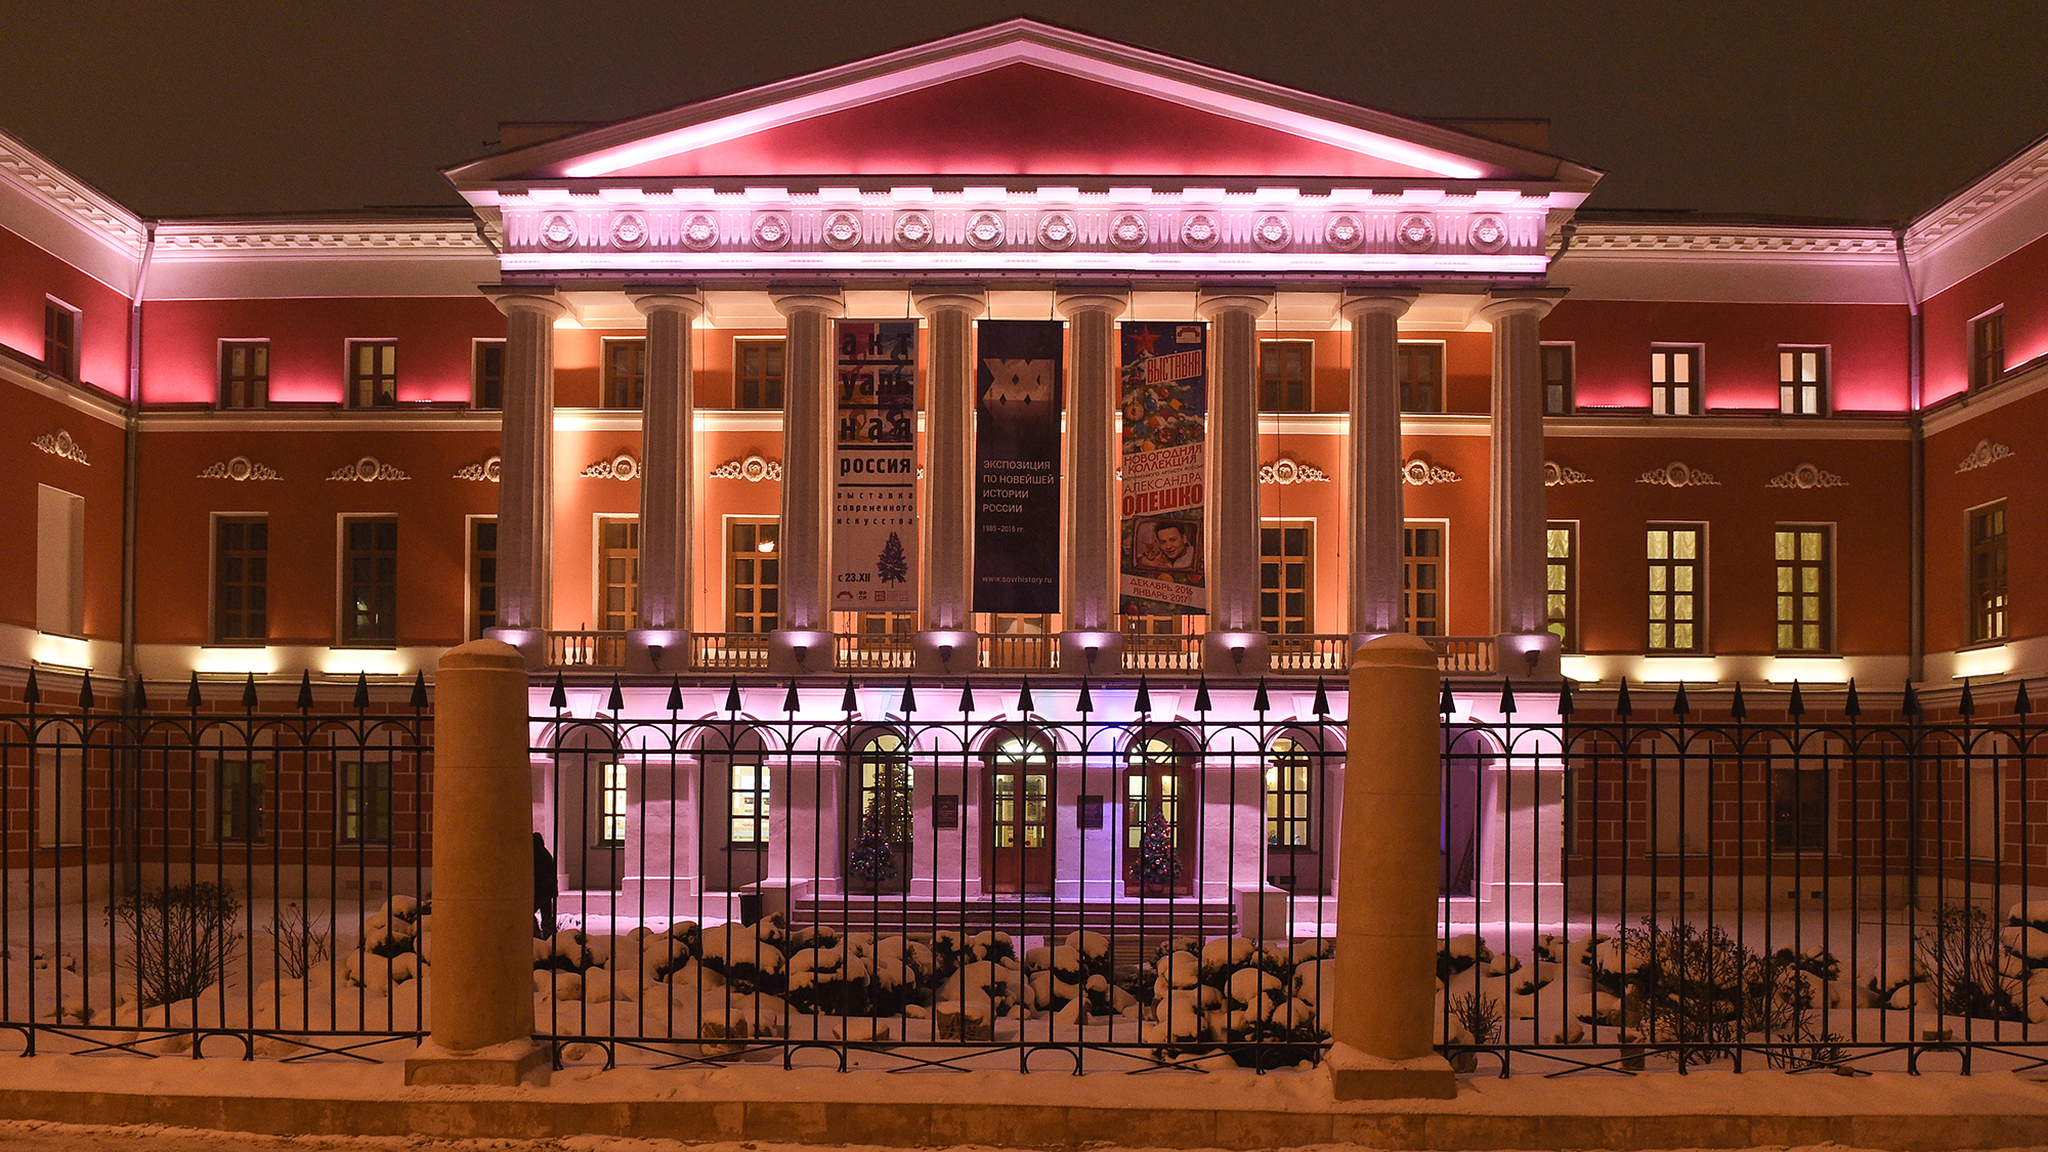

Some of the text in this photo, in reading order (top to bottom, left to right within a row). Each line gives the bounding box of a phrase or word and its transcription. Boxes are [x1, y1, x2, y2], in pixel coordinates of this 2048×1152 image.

[842, 333, 911, 355] акт
[1147, 351, 1200, 383] ВЫСТАВКА
[841, 418, 910, 440] ная
[1124, 445, 1202, 466] НОВОГОДНЯЯ
[841, 458, 910, 476] россия
[983, 460, 1051, 471] ЭКСПОЗИЦИЯ
[1128, 455, 1196, 474] КОЛЛЕКЦИЯ
[983, 474, 1054, 484] ПО НОВЕЙШЕЙ
[1124, 472, 1202, 494] АЛЕКСАНДРА
[983, 489, 1029, 498] ИСТОРИИ
[1123, 484, 1203, 516] ОЛЕШКО
[983, 504, 1022, 513] РОССИИ
[837, 518, 913, 526] искусства
[845, 573, 870, 582] 23.XII
[982, 576, 1052, 584] www.sovrhistory.ru
[1130, 578, 1193, 595] ДЕКАБРЬ 2016
[1133, 588, 1188, 603] ЯНВАРЬ 2017
